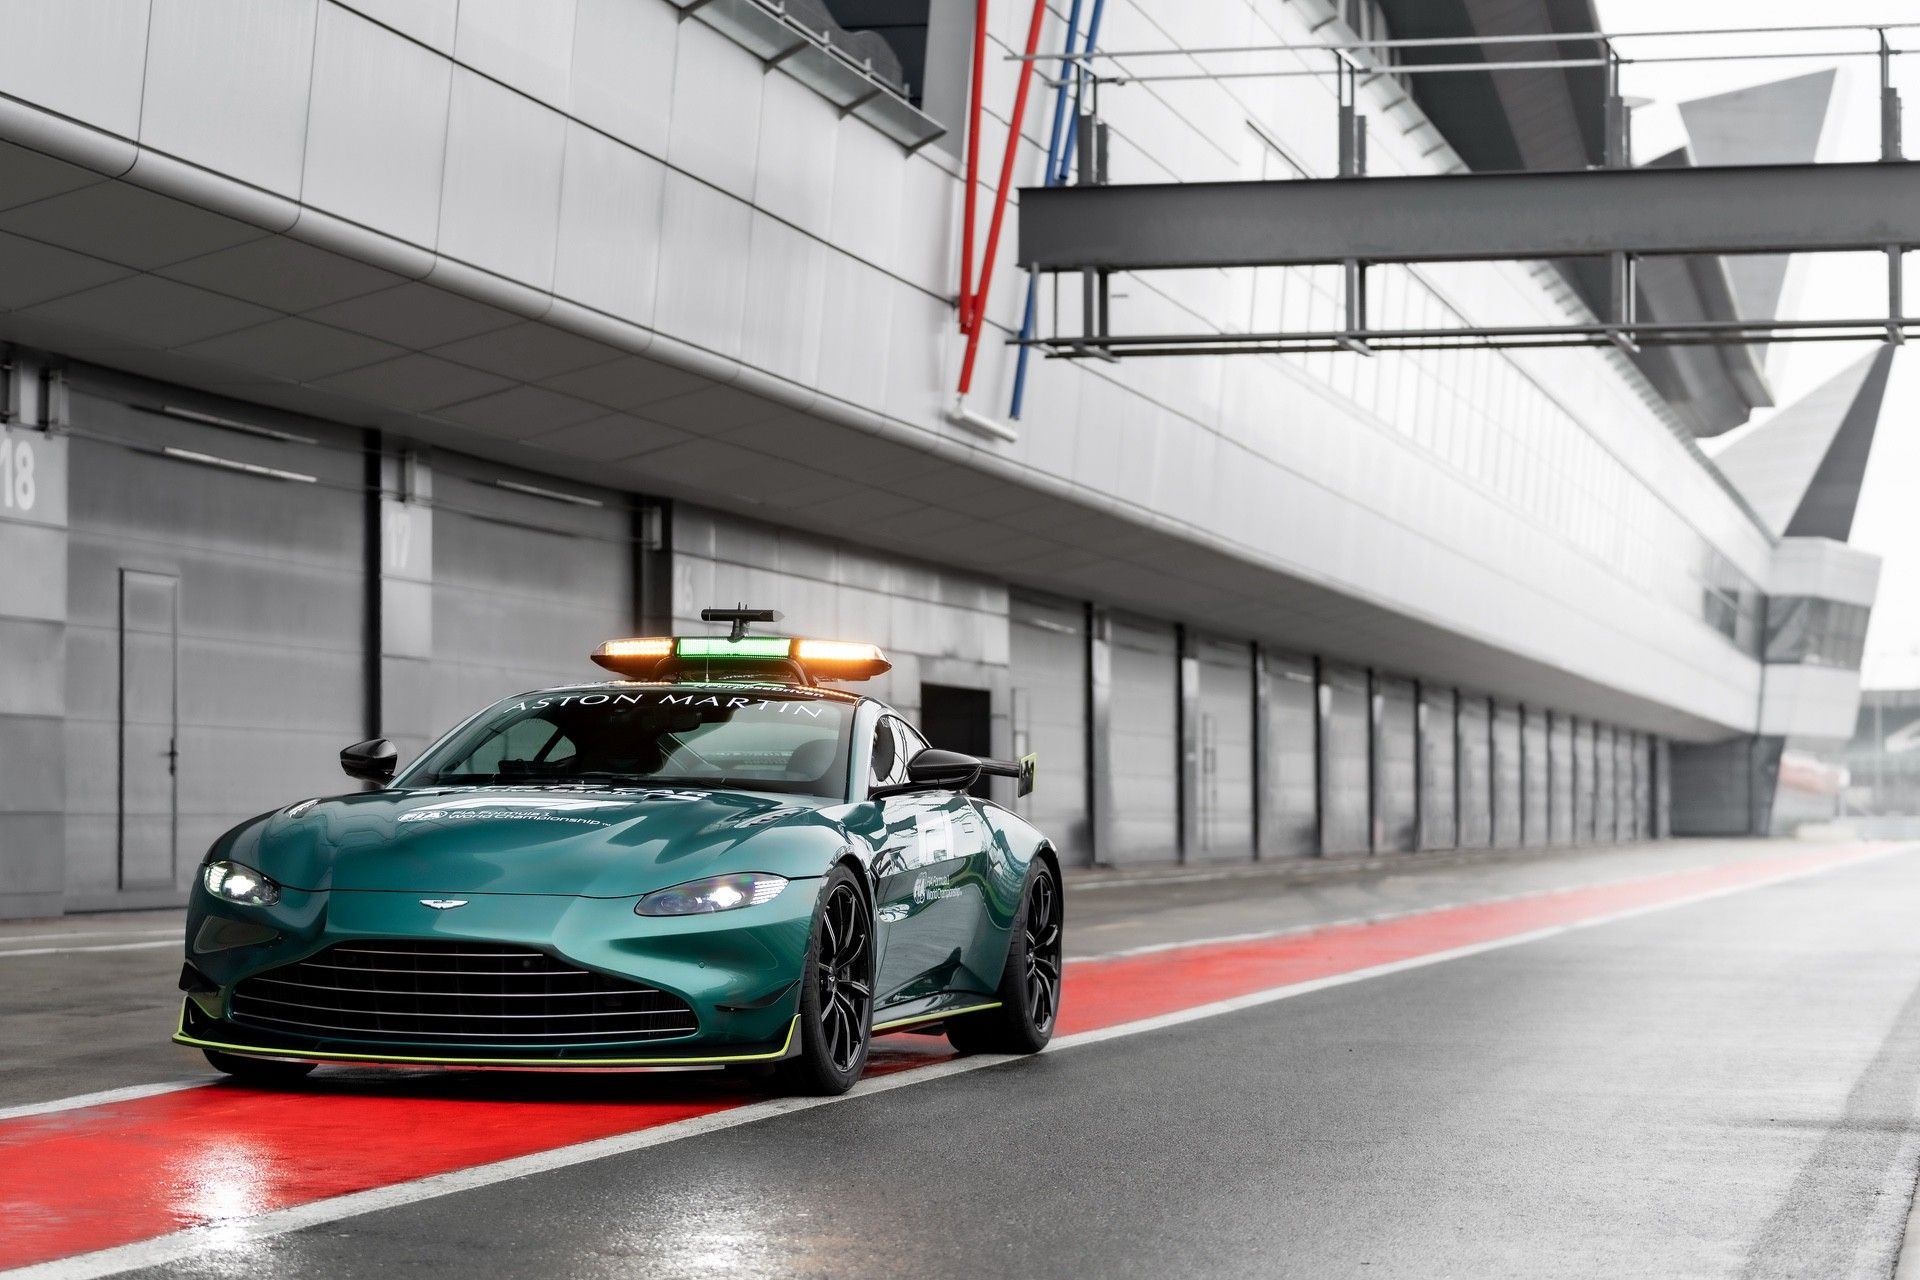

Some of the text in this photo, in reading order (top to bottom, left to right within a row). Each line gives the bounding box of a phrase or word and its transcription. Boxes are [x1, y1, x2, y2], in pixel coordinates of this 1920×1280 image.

[0, 438, 35, 511] 18
[503, 693, 824, 720] ASTON MARTIN
